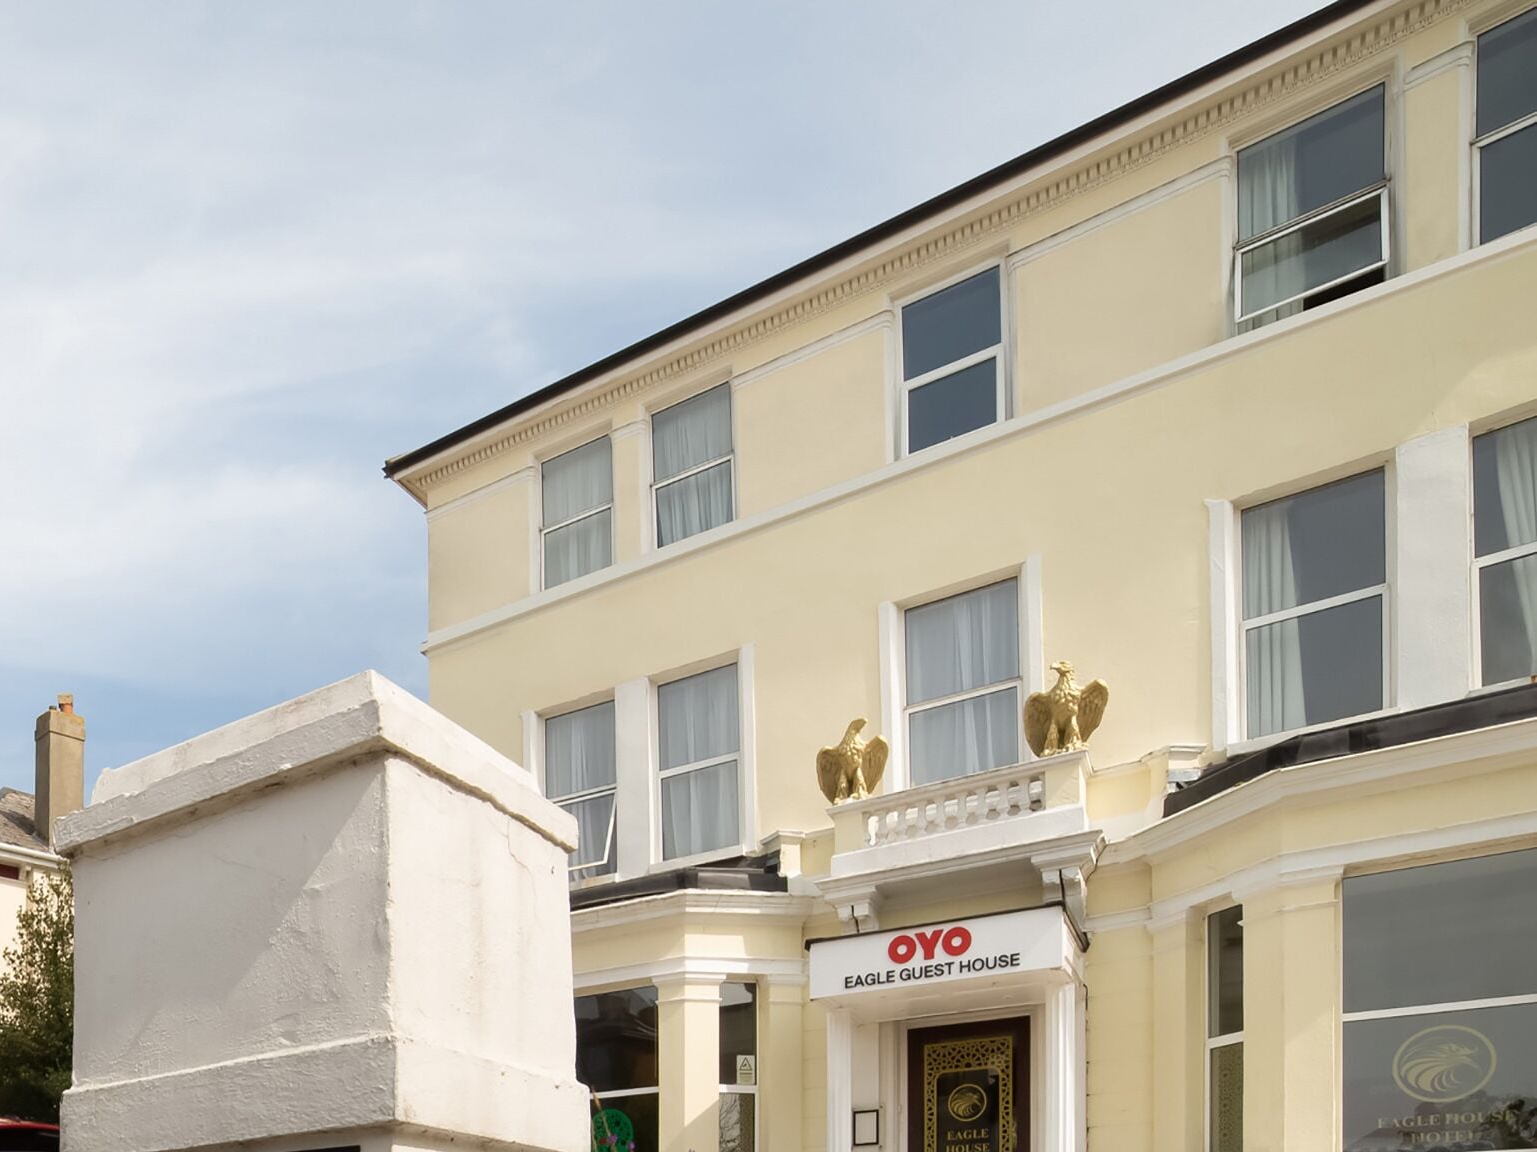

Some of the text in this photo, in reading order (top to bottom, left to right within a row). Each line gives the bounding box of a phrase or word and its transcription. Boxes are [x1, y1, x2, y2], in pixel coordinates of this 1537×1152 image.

[888, 926, 972, 964] OYO
[845, 953, 1020, 989] EAGLE GUEST HOUSE
[947, 1128, 990, 1140] EAGLE
[1377, 1110, 1514, 1130] EAGLE HOUSE
